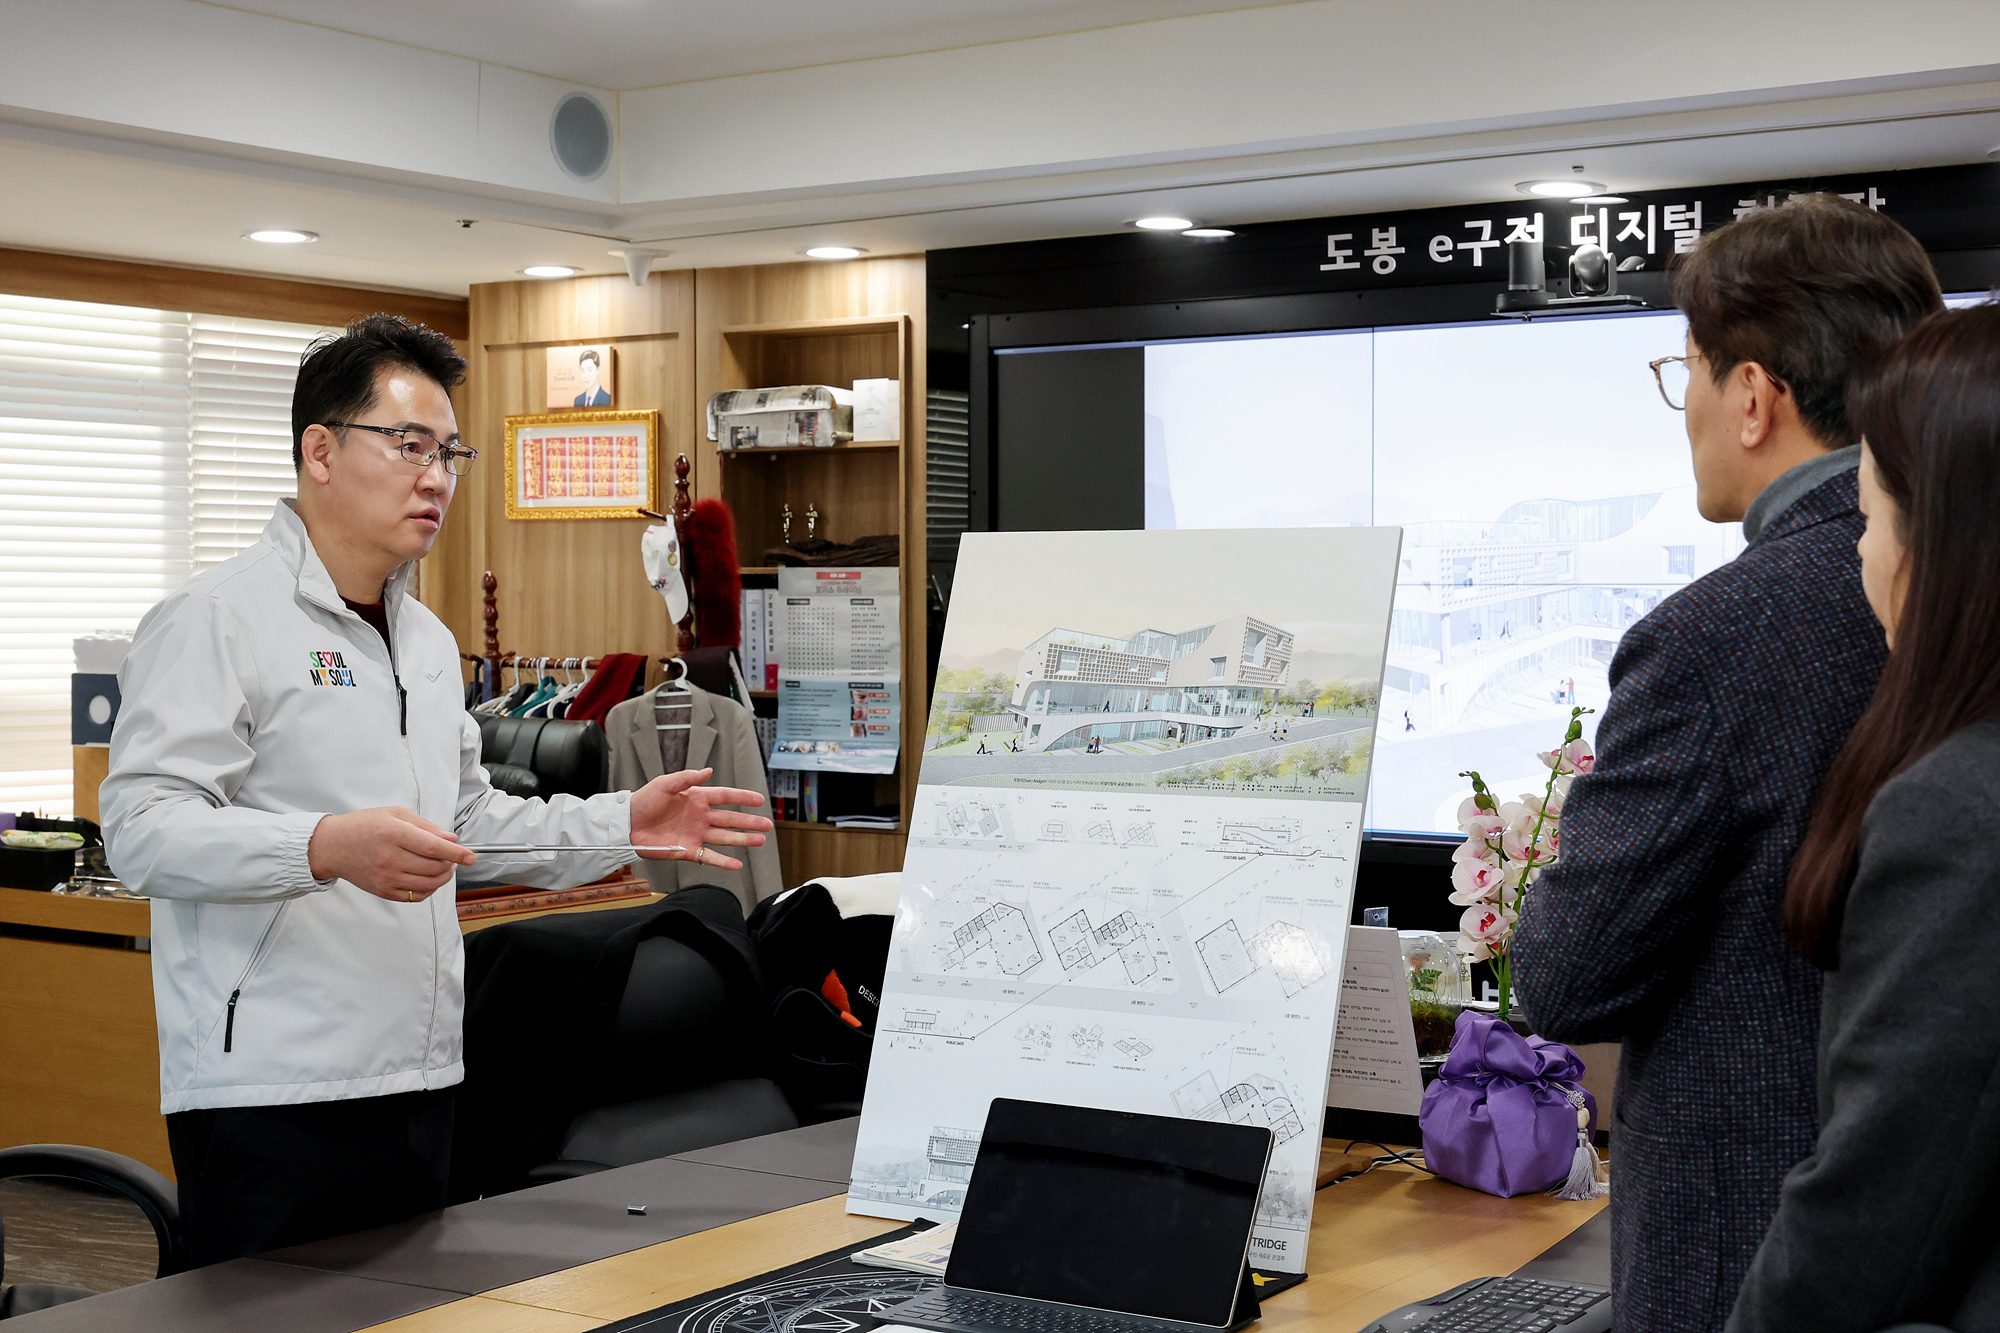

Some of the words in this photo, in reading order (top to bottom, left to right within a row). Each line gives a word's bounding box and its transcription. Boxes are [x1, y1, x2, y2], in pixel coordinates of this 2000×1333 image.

[1319, 226, 1406, 275] 도봉
[1570, 200, 1703, 254] 디지털
[1252, 1237, 1287, 1251] TRIDGE
